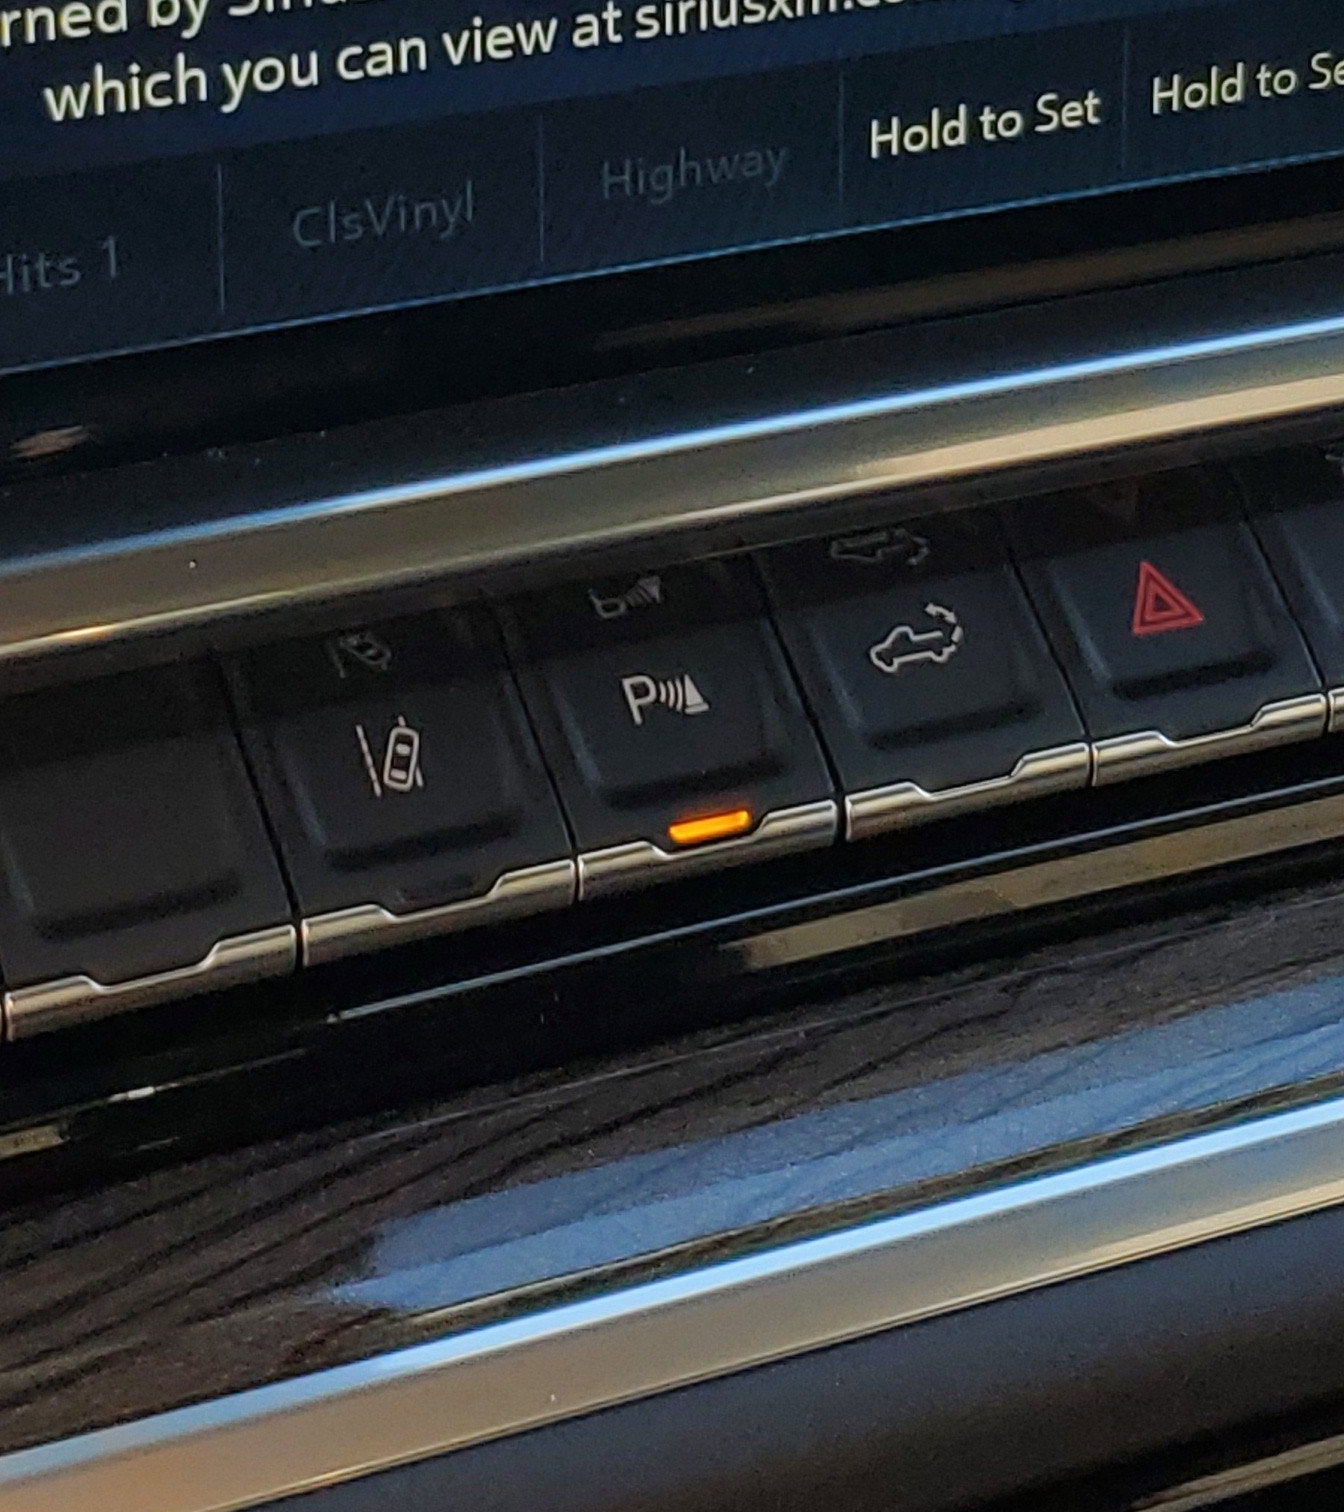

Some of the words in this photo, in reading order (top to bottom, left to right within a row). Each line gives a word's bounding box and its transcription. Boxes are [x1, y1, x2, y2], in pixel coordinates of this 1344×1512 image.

[45, 52, 208, 122] which
[221, 50, 320, 113] you
[336, 34, 427, 80] can
[442, 16, 559, 65] view
[571, 1, 622, 48] at
[1151, 61, 1247, 115] Hold
[1255, 60, 1298, 99] to
[869, 107, 969, 160] Hold
[979, 100, 1025, 142] to
[1034, 88, 1103, 133] Set
[602, 141, 790, 205] Highway
[291, 179, 476, 252] ClsVinyl
